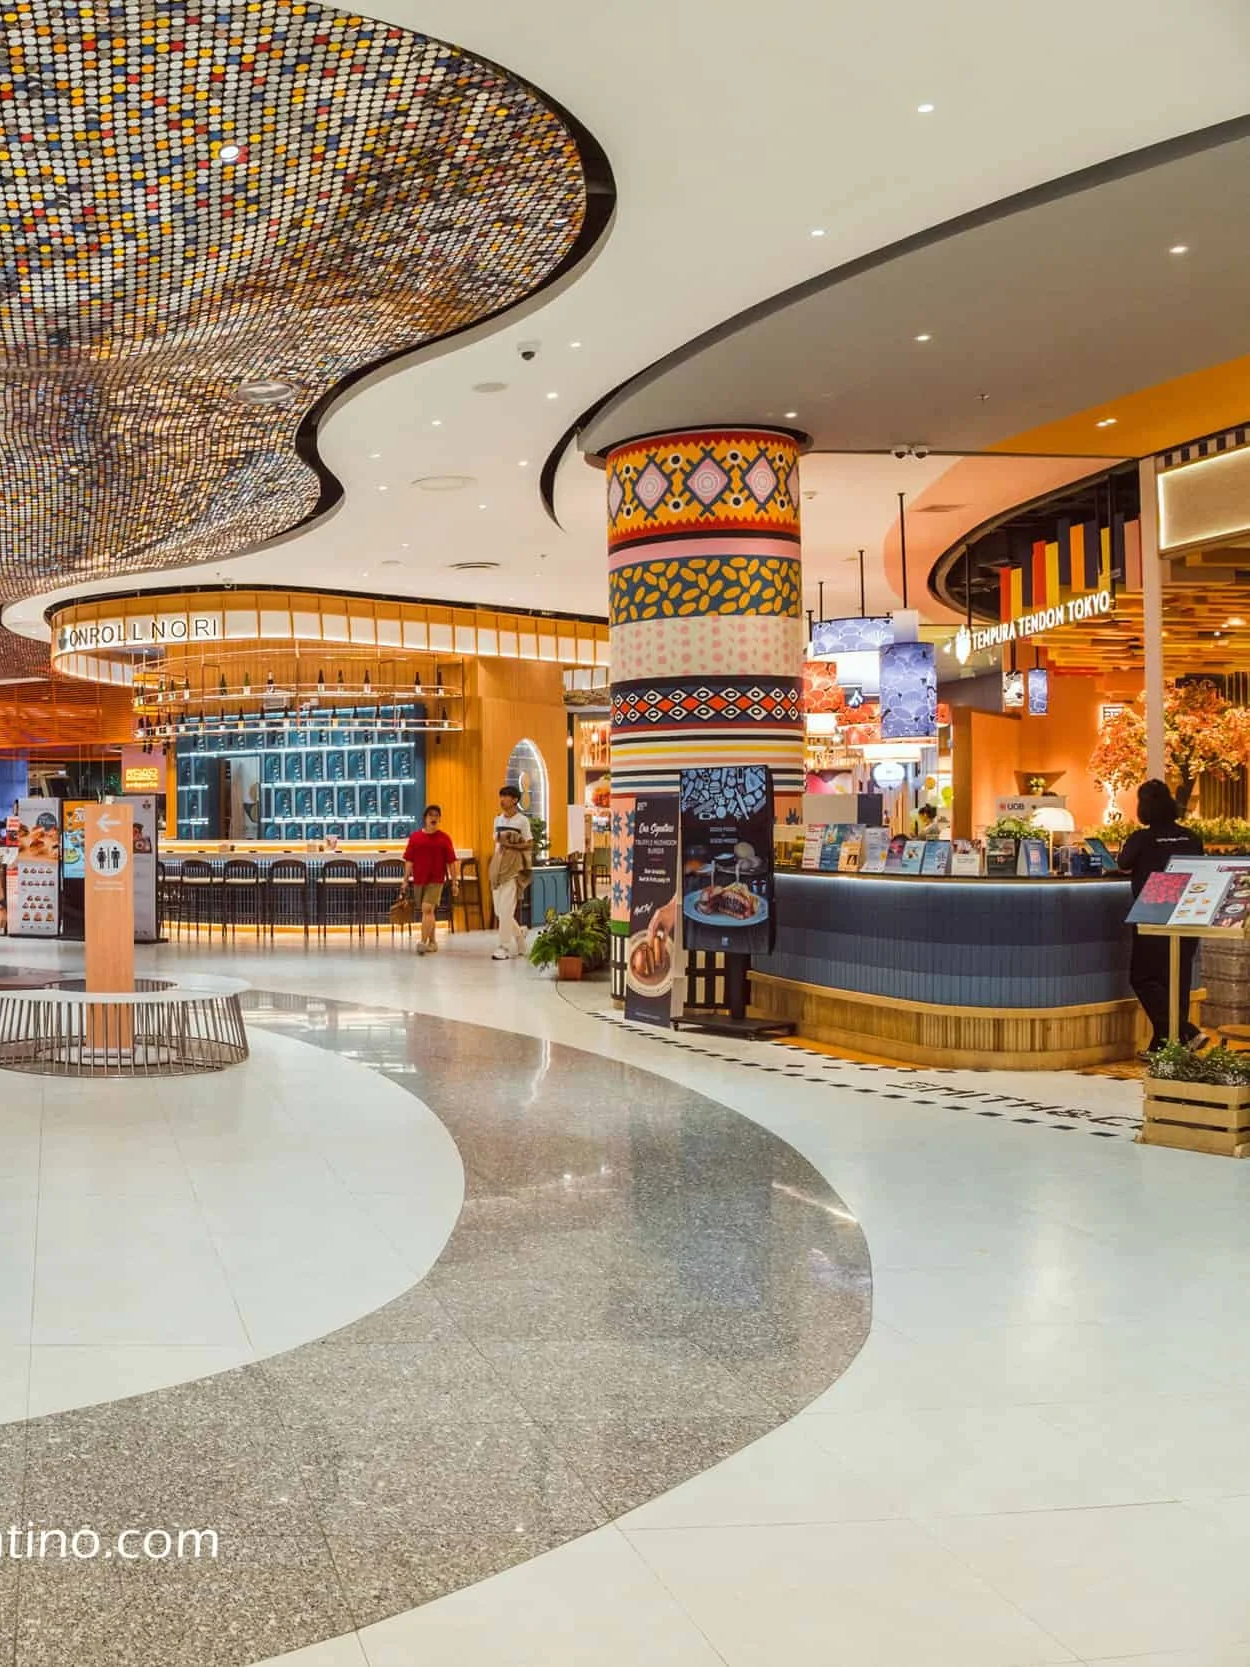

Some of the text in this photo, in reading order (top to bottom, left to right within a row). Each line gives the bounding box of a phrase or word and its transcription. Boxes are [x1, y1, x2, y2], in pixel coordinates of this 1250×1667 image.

[972, 590, 1110, 651] TEMPURA TENDON TOKYO
[1007, 803, 1025, 811] UOB
